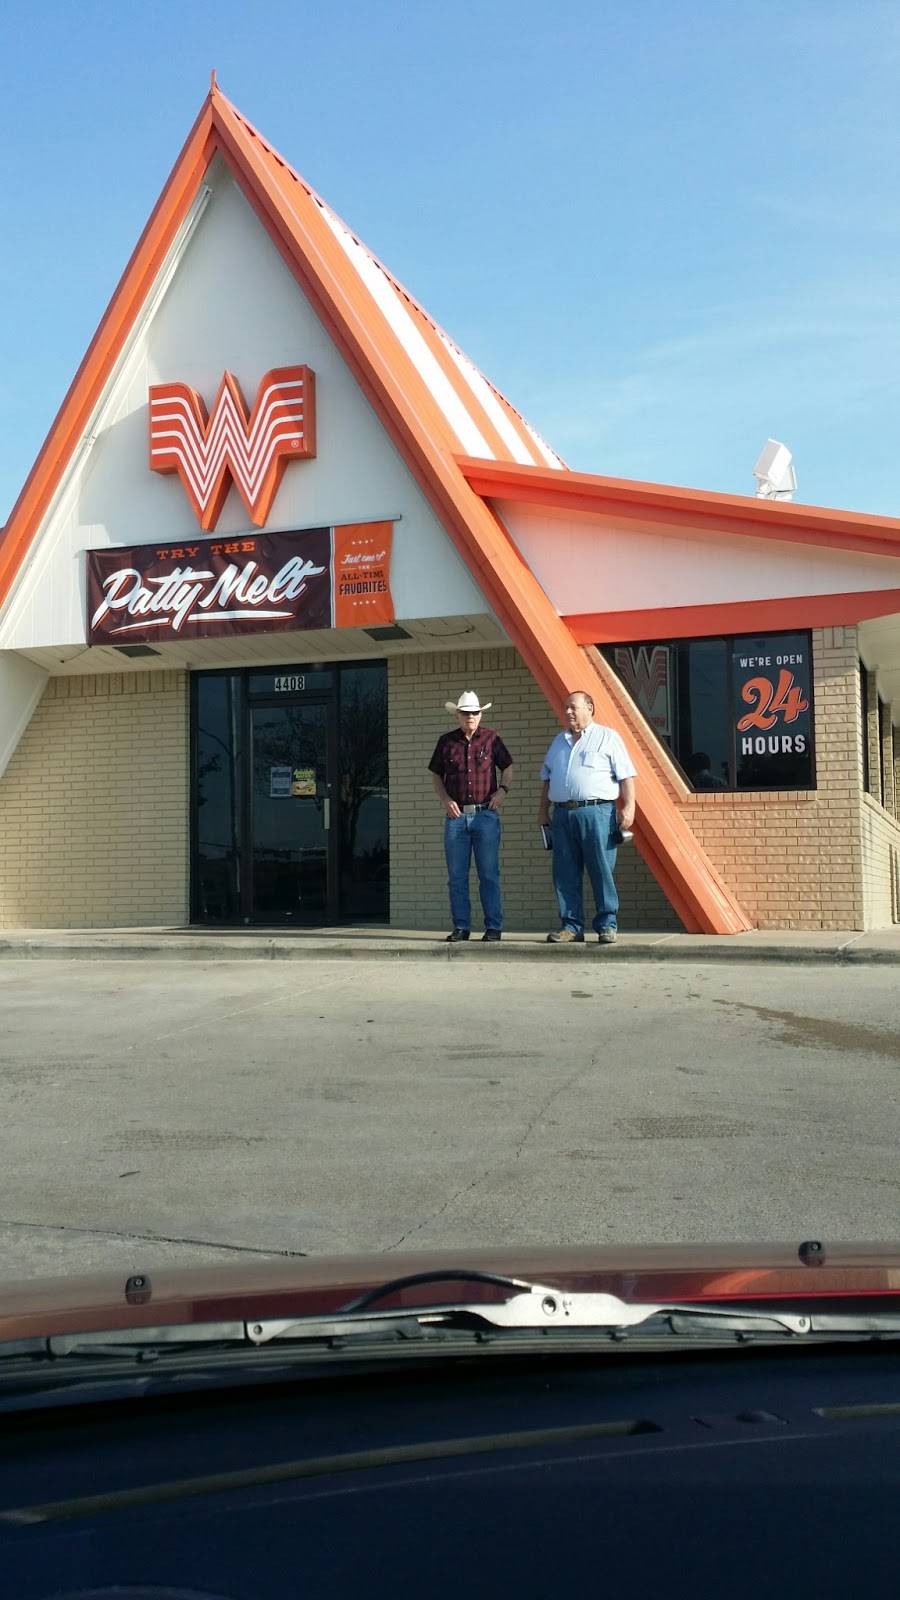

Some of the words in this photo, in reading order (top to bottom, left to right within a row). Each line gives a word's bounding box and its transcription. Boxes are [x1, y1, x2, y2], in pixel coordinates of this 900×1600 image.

[149, 364, 317, 532] W
[156, 547, 200, 560] TRY
[210, 541, 256, 555] THE
[91, 566, 215, 632] Patty
[198, 555, 326, 608] Melt
[740, 656, 771, 668] WE'RE
[776, 654, 803, 665] OPEN
[275, 676, 304, 690] 4408
[737, 669, 809, 731] 24
[742, 734, 806, 755] HOURS
